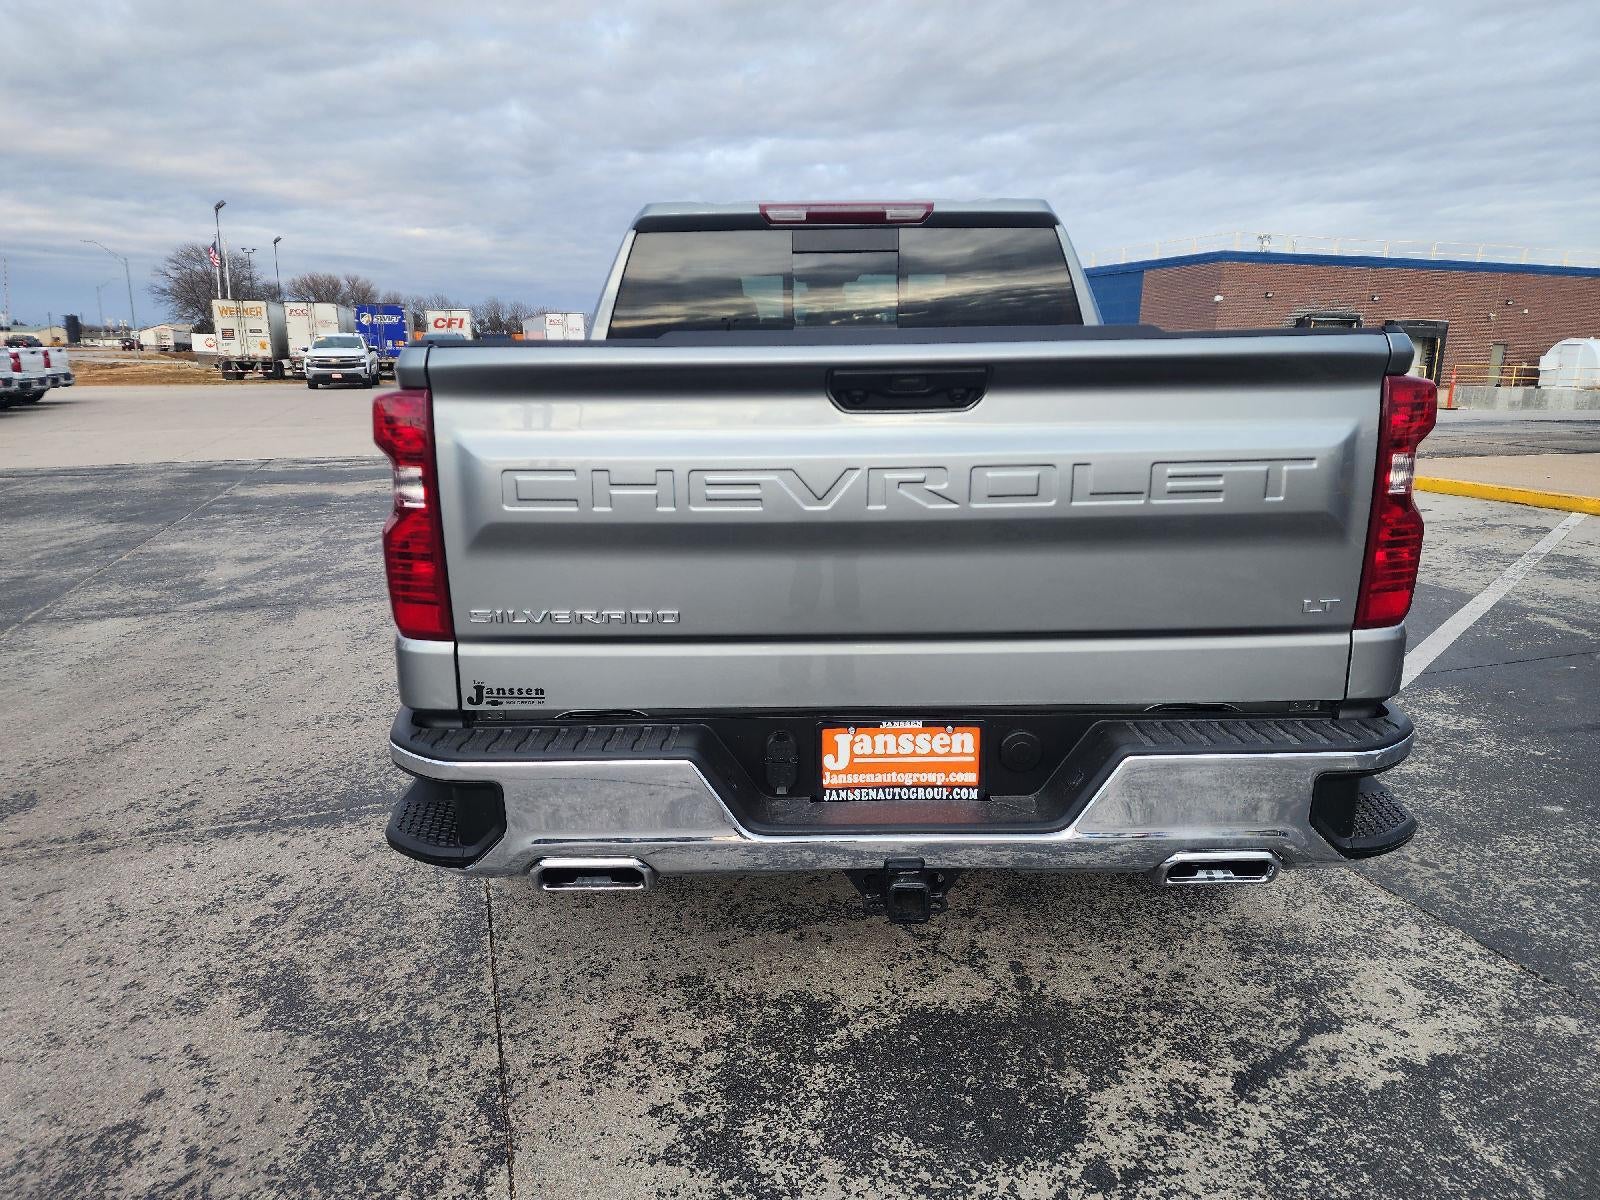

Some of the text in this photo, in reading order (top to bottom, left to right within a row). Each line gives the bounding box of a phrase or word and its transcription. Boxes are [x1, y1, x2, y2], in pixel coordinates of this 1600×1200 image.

[217, 305, 263, 317] WERNER
[373, 314, 401, 324] SWIFT
[433, 317, 464, 329] CFI
[501, 457, 1318, 512] CHEVROLET
[1302, 598, 1341, 613] LT
[468, 608, 681, 625] SILVERADO
[466, 685, 545, 706] Janssen
[880, 720, 923, 729] JANSSEN
[823, 732, 975, 771] Janssen
[823, 771, 977, 786] Janssenautogroup.com
